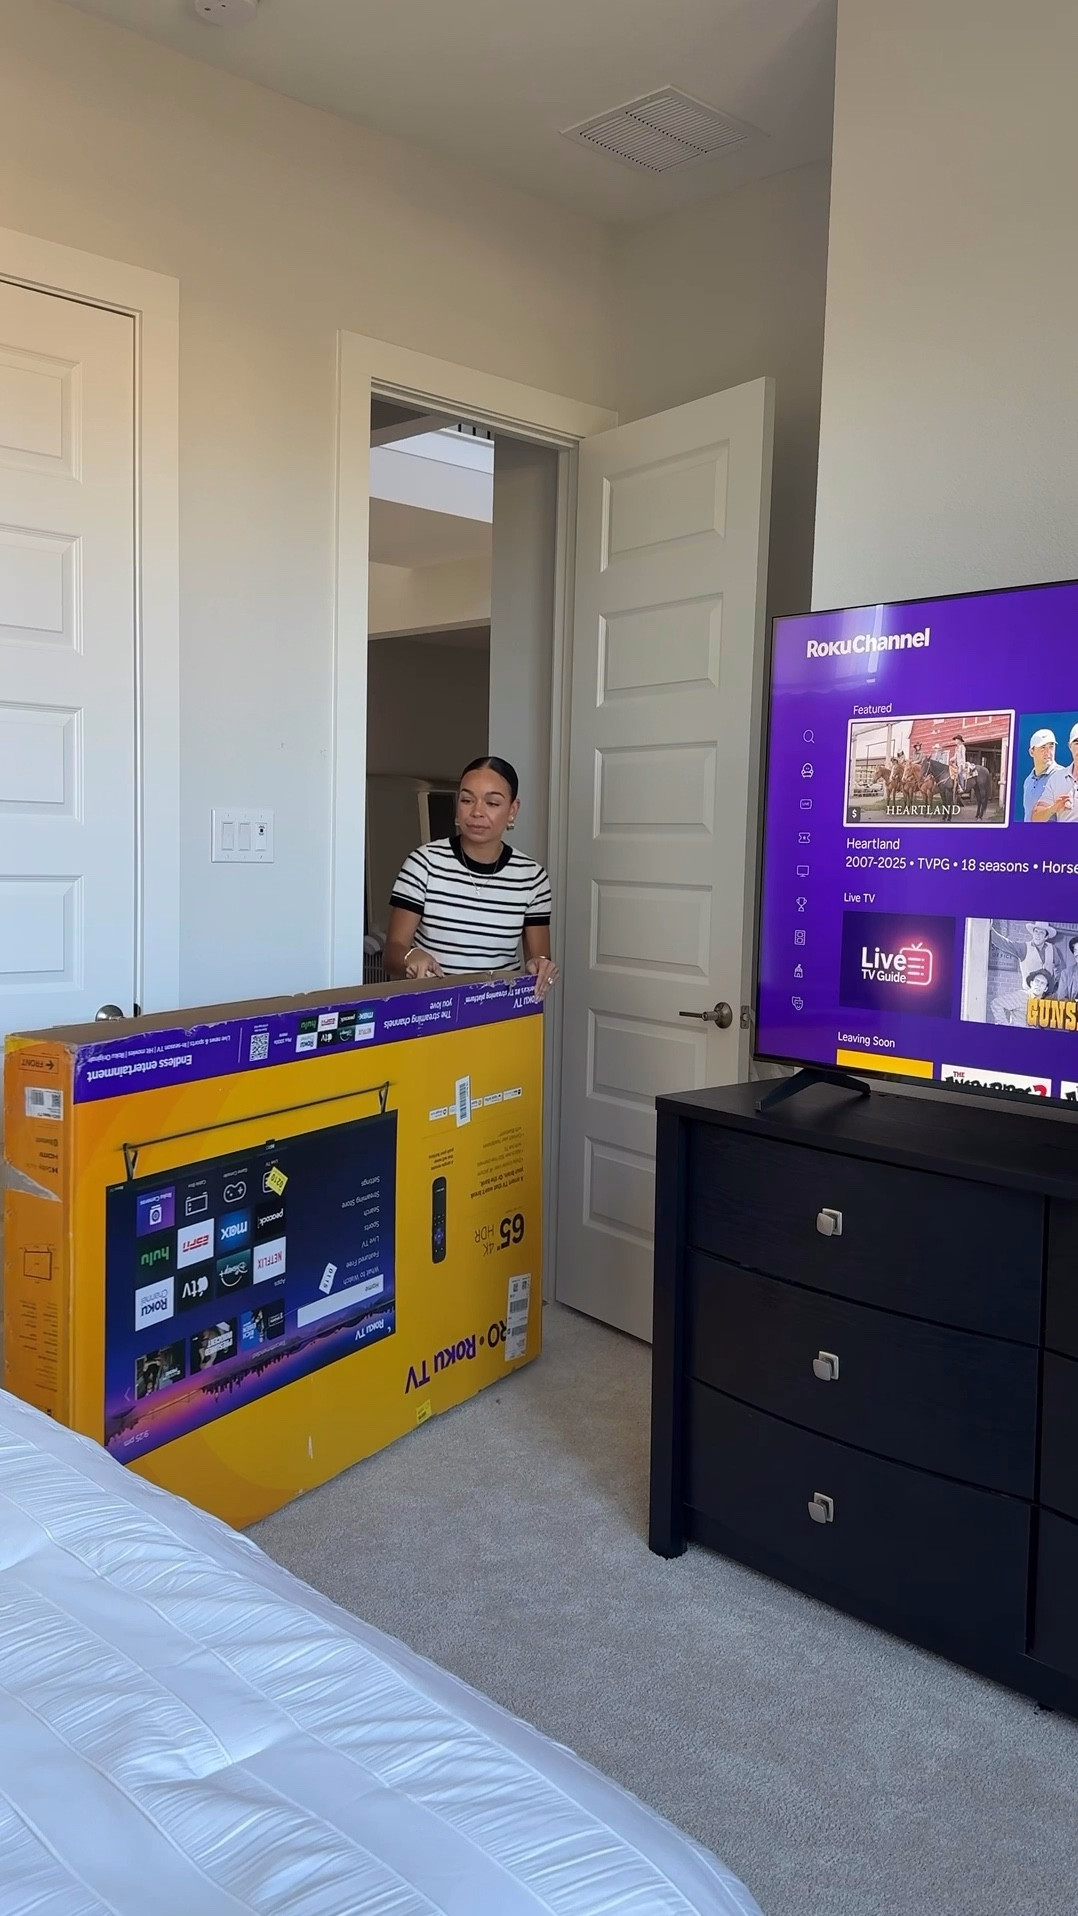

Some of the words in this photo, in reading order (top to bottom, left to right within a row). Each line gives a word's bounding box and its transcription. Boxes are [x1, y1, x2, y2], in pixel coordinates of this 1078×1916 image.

[853, 703, 892, 715] Featured
[886, 804, 961, 816] HEARTLAND
[846, 837, 900, 850] Heartland
[845, 856, 906, 869] 2007-2025
[917, 858, 950, 870] TVPG
[961, 859, 976, 871] 18
[978, 862, 1029, 873] seasons
[1042, 861, 1078, 874] Horse
[843, 892, 861, 903] Live
[863, 893, 876, 903] TV
[861, 947, 907, 970] Live
[861, 969, 876, 980] TV
[876, 970, 907, 984] Guide
[429, 1001, 440, 1010] love
[442, 997, 452, 1007] you
[512, 997, 522, 1008] TV
[411, 1011, 440, 1024] streaming
[440, 1010, 451, 1018] The
[1026, 997, 1078, 1032] GUNS
[383, 1016, 410, 1028] channels
[837, 1031, 870, 1047] Leaving
[872, 1036, 895, 1048] Soon
[21, 1058, 43, 1068] FRONT
[158, 1054, 192, 1068] Endless
[86, 1060, 157, 1082] entertainment
[360, 1175, 379, 1187] Settings
[341, 1198, 355, 1208] Store
[356, 1190, 379, 1203] Streaming
[258, 1207, 283, 1225] peacock
[363, 1205, 379, 1216] Search
[220, 1221, 247, 1240] max
[363, 1219, 379, 1230] Sports
[369, 1235, 379, 1244] Live
[474, 1223, 494, 1243] HDR
[182, 1234, 209, 1252] ESPN
[361, 1239, 368, 1247] TV
[482, 1241, 494, 1256] 4K
[140, 1246, 169, 1265] hulu
[257, 1251, 282, 1269] NETFLIX
[357, 1250, 379, 1264] Featured
[219, 1261, 248, 1277] Disney+
[345, 1258, 356, 1268] Free
[360, 1271, 365, 1279] to
[366, 1266, 379, 1277] What
[274, 1278, 285, 1286] Apps
[342, 1273, 359, 1285] Watch
[364, 1282, 379, 1292] Home
[140, 1288, 168, 1306] Channel
[140, 1297, 167, 1316] Roku
[366, 1318, 384, 1334] Roku
[354, 1328, 365, 1340] TV
[433, 1334, 475, 1373] Roku
[404, 1359, 430, 1394] TV
